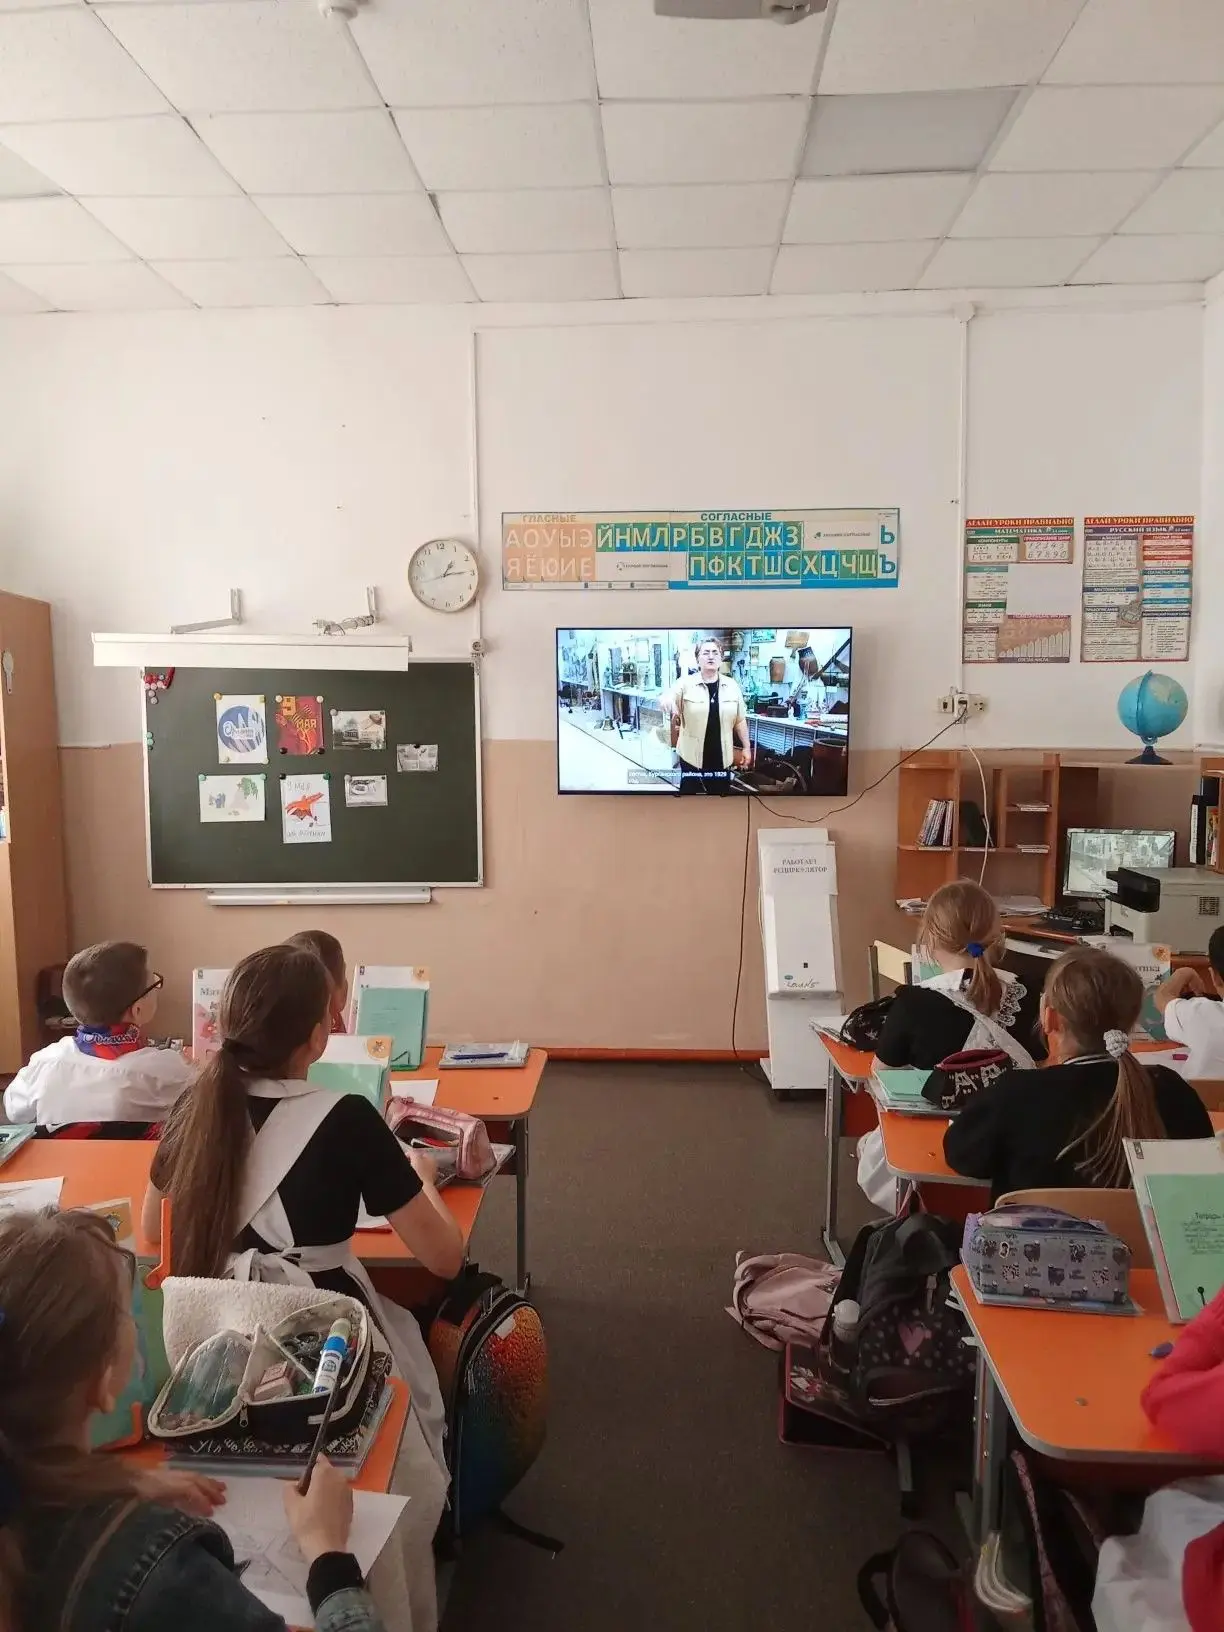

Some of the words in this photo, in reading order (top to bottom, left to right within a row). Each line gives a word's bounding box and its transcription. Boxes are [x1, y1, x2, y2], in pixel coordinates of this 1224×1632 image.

[522, 514, 577, 523] ГЛАСНЫЕ
[700, 512, 772, 521] СОГЛАСНЫЕ
[994, 527, 1043, 535] МАТЕМАТИКА
[782, 858, 818, 866] РАБОТАЕТ
[773, 866, 829, 874] РЕЦИРКУЛЯТОР
